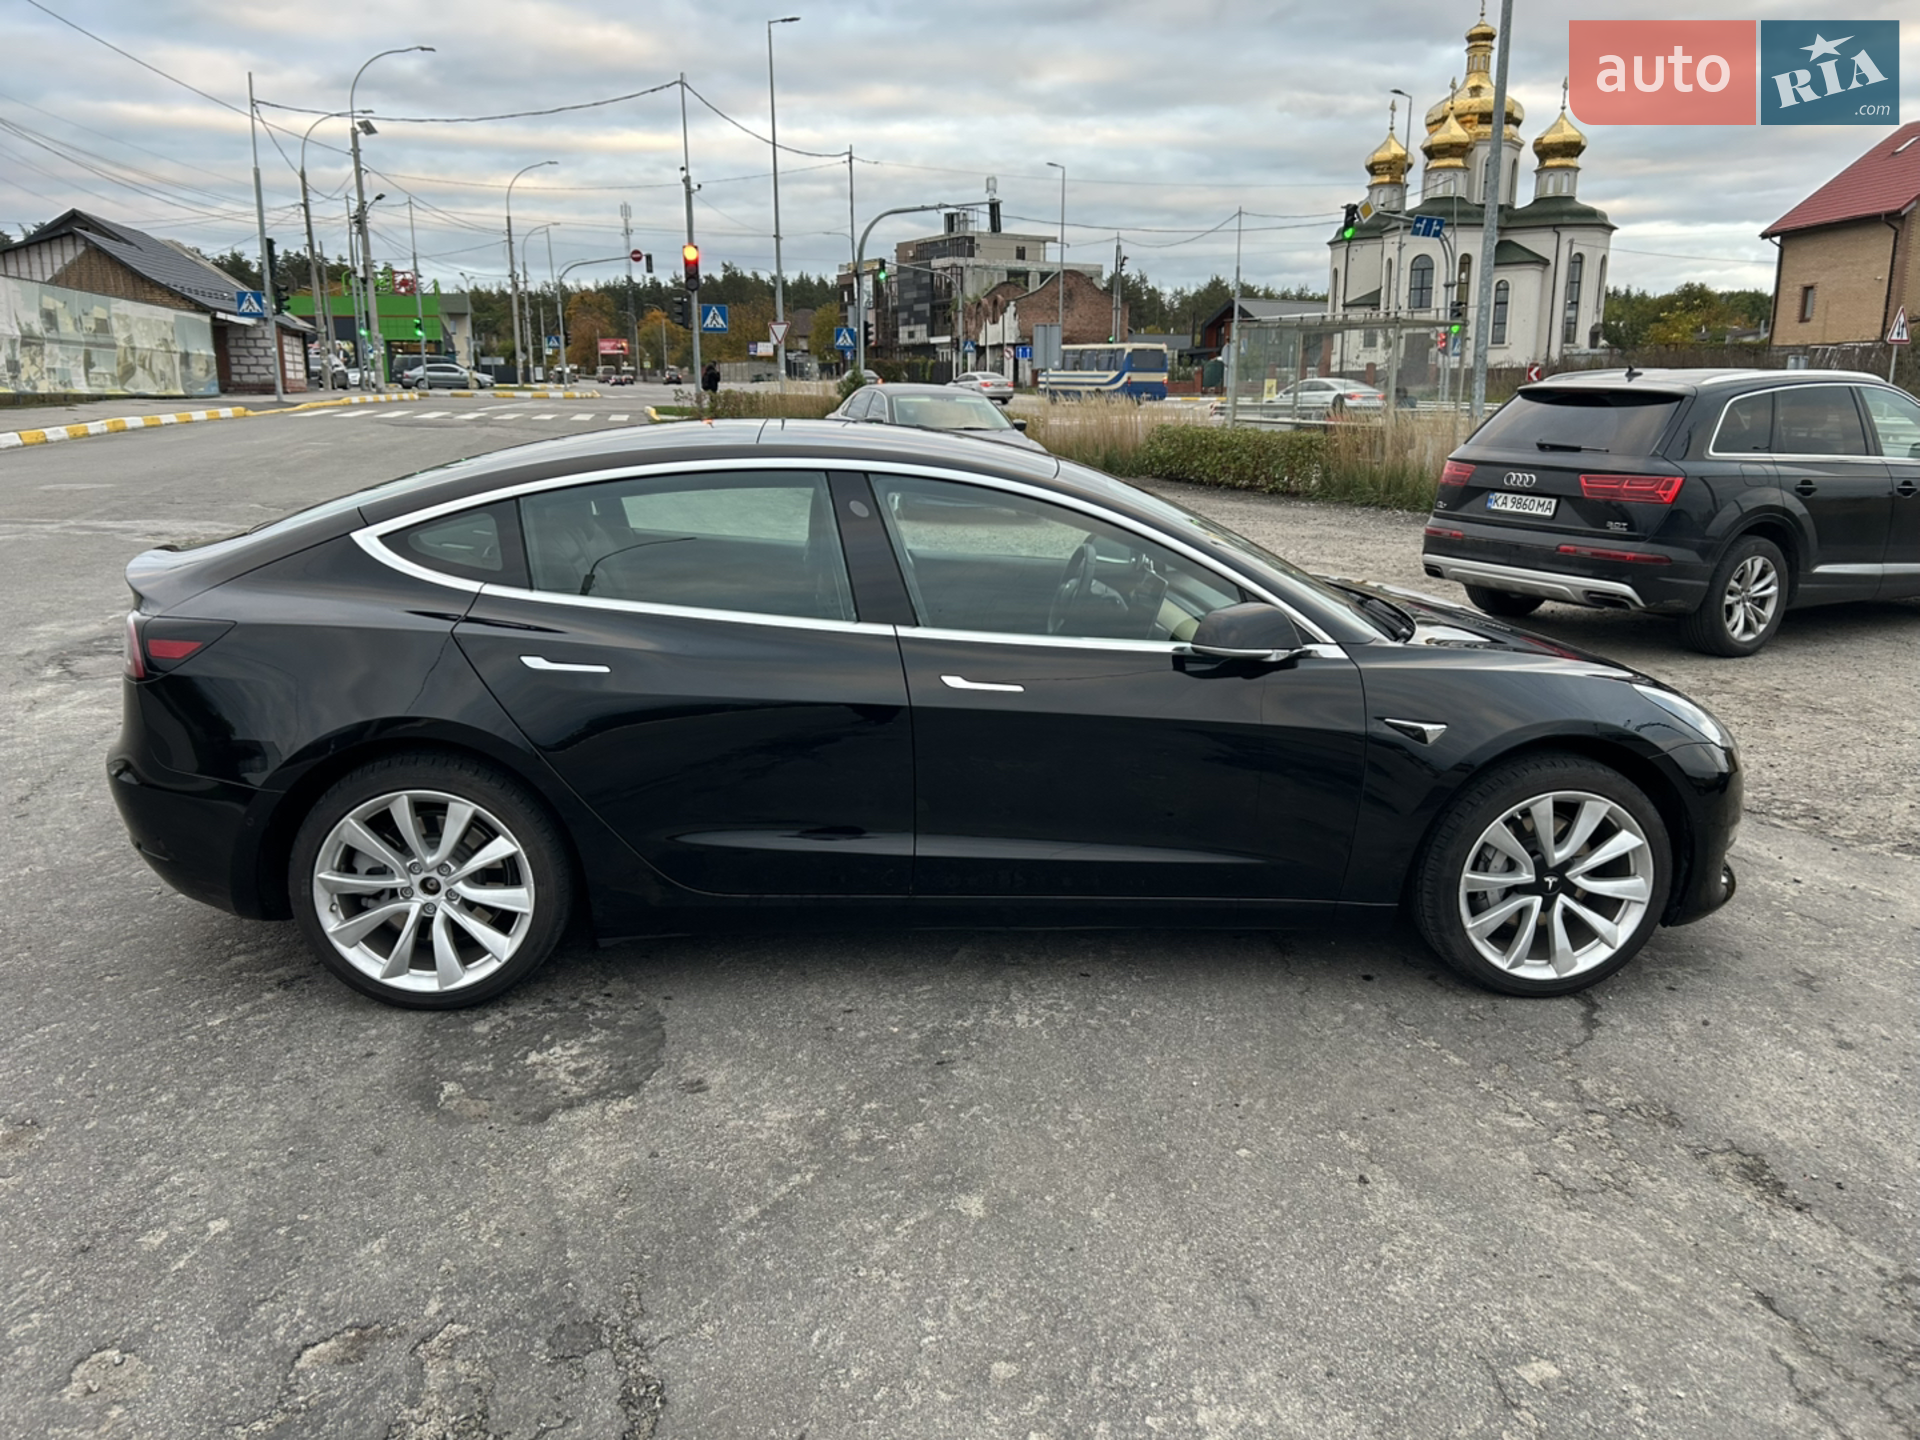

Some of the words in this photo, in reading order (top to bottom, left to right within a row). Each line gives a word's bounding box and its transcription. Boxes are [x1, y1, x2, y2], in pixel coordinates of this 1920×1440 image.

[1493, 494, 1508, 508] KA
[1510, 496, 1536, 512] 9860
[1536, 499, 1553, 514] MA
